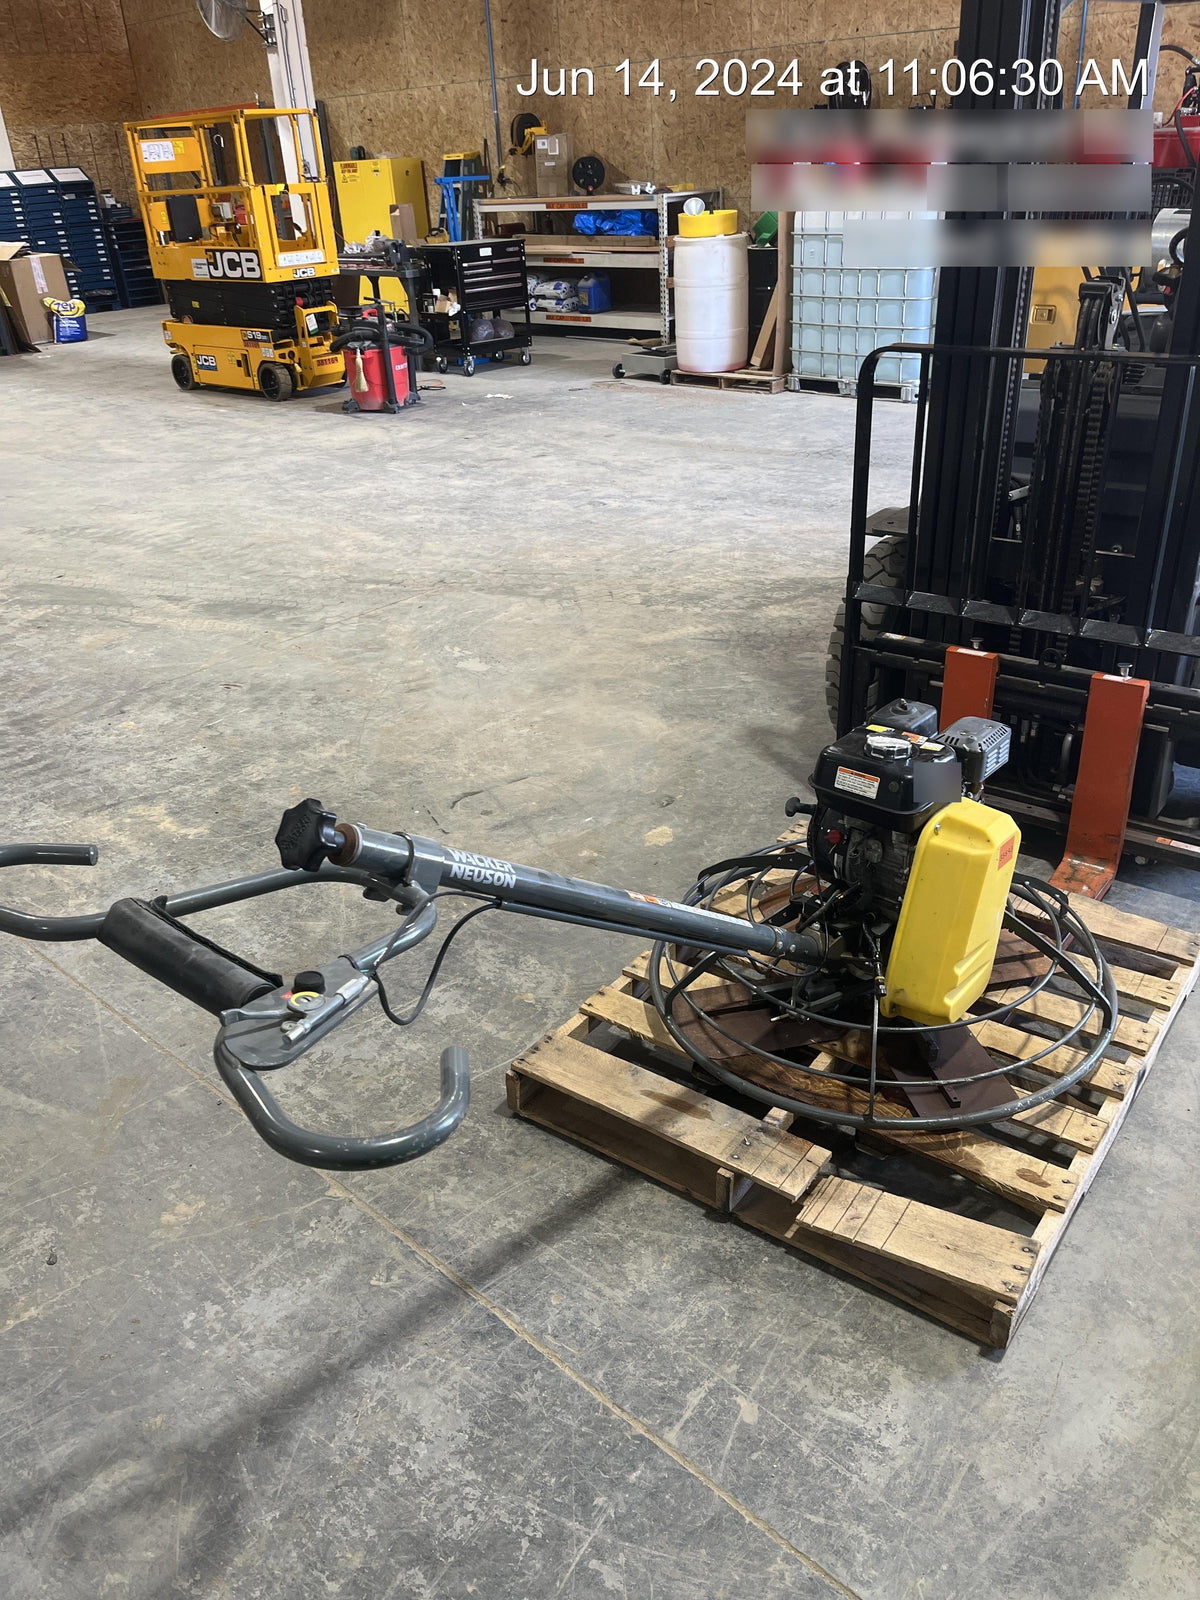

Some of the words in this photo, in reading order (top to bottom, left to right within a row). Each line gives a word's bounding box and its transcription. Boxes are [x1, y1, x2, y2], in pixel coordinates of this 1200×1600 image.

[208, 251, 262, 279] JCB
[293, 267, 316, 278] JCB
[247, 330, 262, 340] S19
[196, 354, 217, 367] JCB
[446, 848, 517, 874] WACKER
[450, 863, 517, 889] NEUSON
